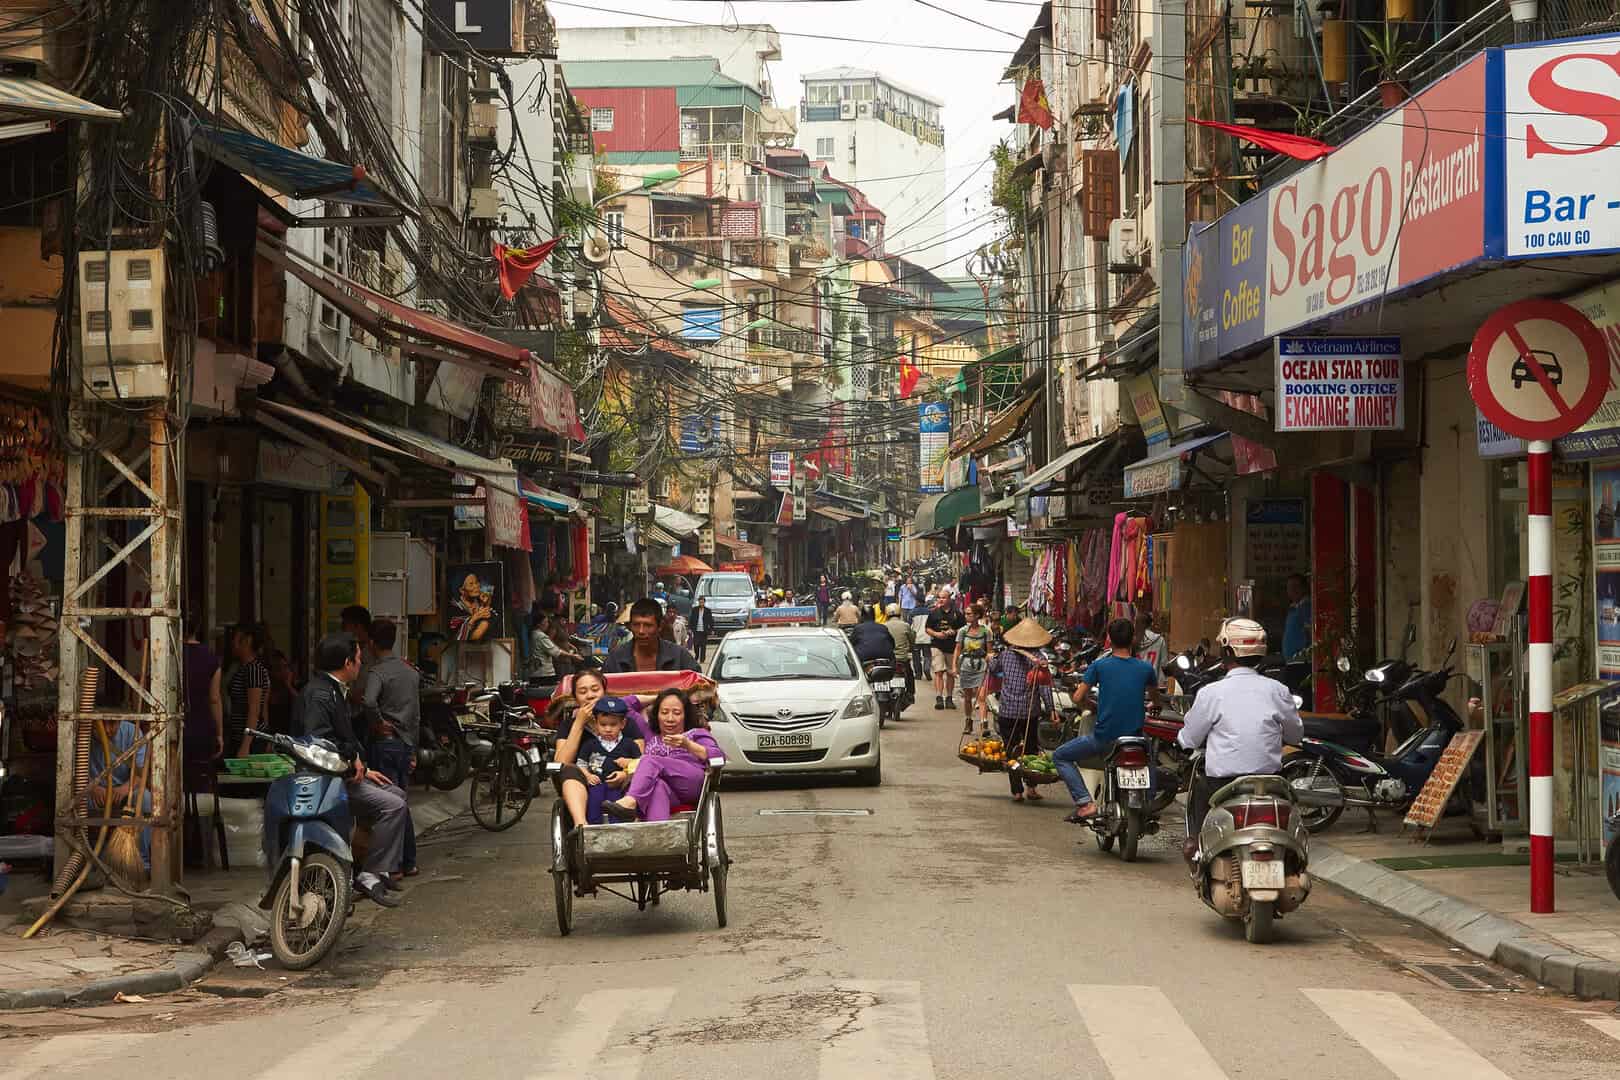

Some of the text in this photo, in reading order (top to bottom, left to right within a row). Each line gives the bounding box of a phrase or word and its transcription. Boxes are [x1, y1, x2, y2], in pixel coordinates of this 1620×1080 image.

[455, 1, 482, 32] L
[1402, 127, 1480, 225] Restaurant
[1524, 189, 1596, 224] Bar
[1231, 224, 1254, 266] Bar
[1269, 166, 1393, 305] Sago
[1524, 230, 1590, 248] 100 CAU GO
[1222, 280, 1260, 330] Coffee
[1306, 341, 1397, 353] Vietnam Airlines
[1282, 359, 1399, 380] OCEAN STAR TOUR
[1285, 383, 1398, 395] BOOKING OFFICE
[1285, 395, 1397, 427] EXCHANGE MONEY
